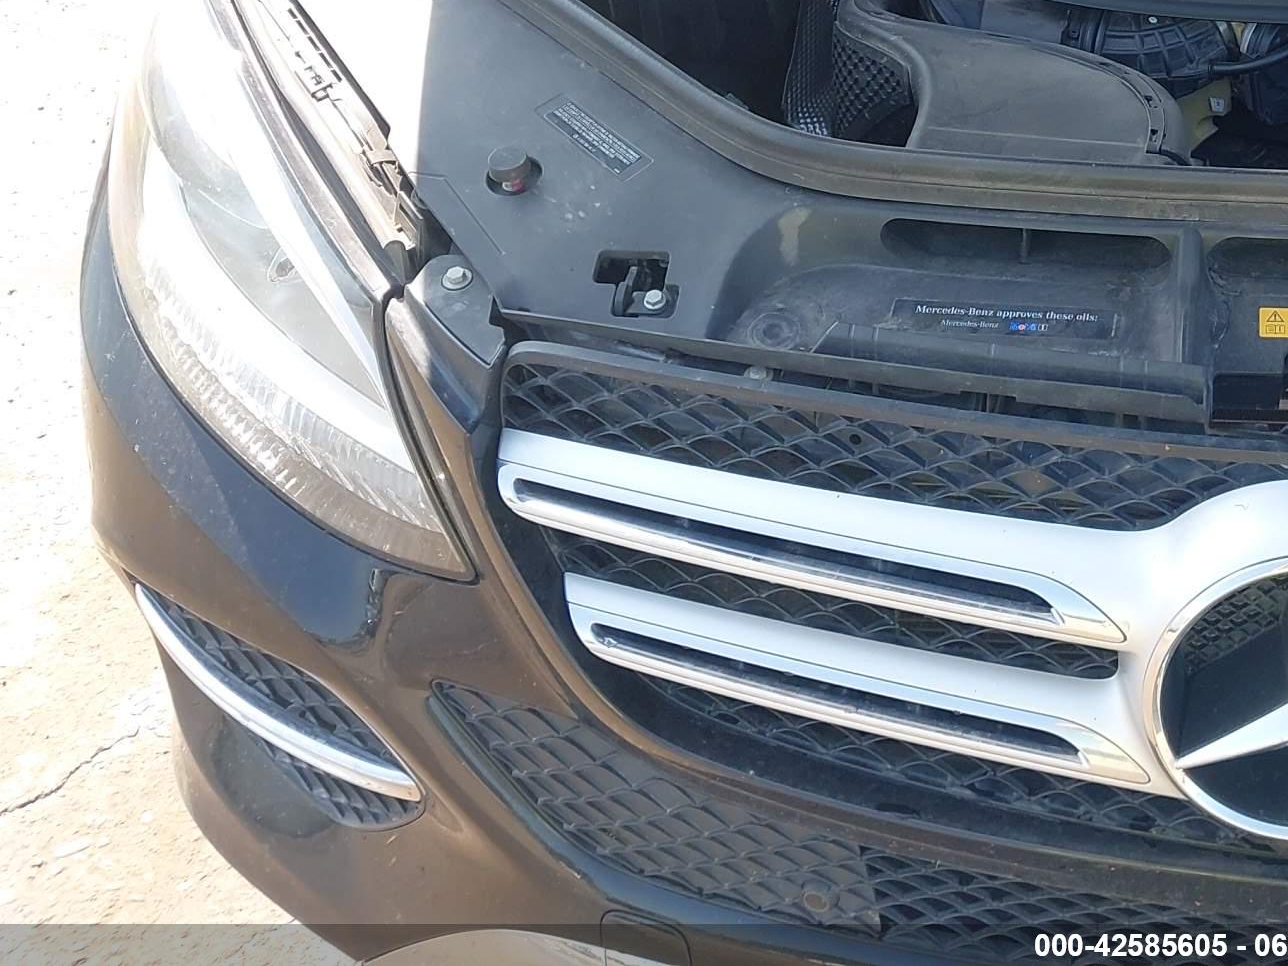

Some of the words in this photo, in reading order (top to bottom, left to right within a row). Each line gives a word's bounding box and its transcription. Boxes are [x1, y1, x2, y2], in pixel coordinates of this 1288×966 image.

[915, 305, 994, 317] Mercedes-Benz
[997, 309, 1043, 320] approves
[1046, 311, 1074, 321] these
